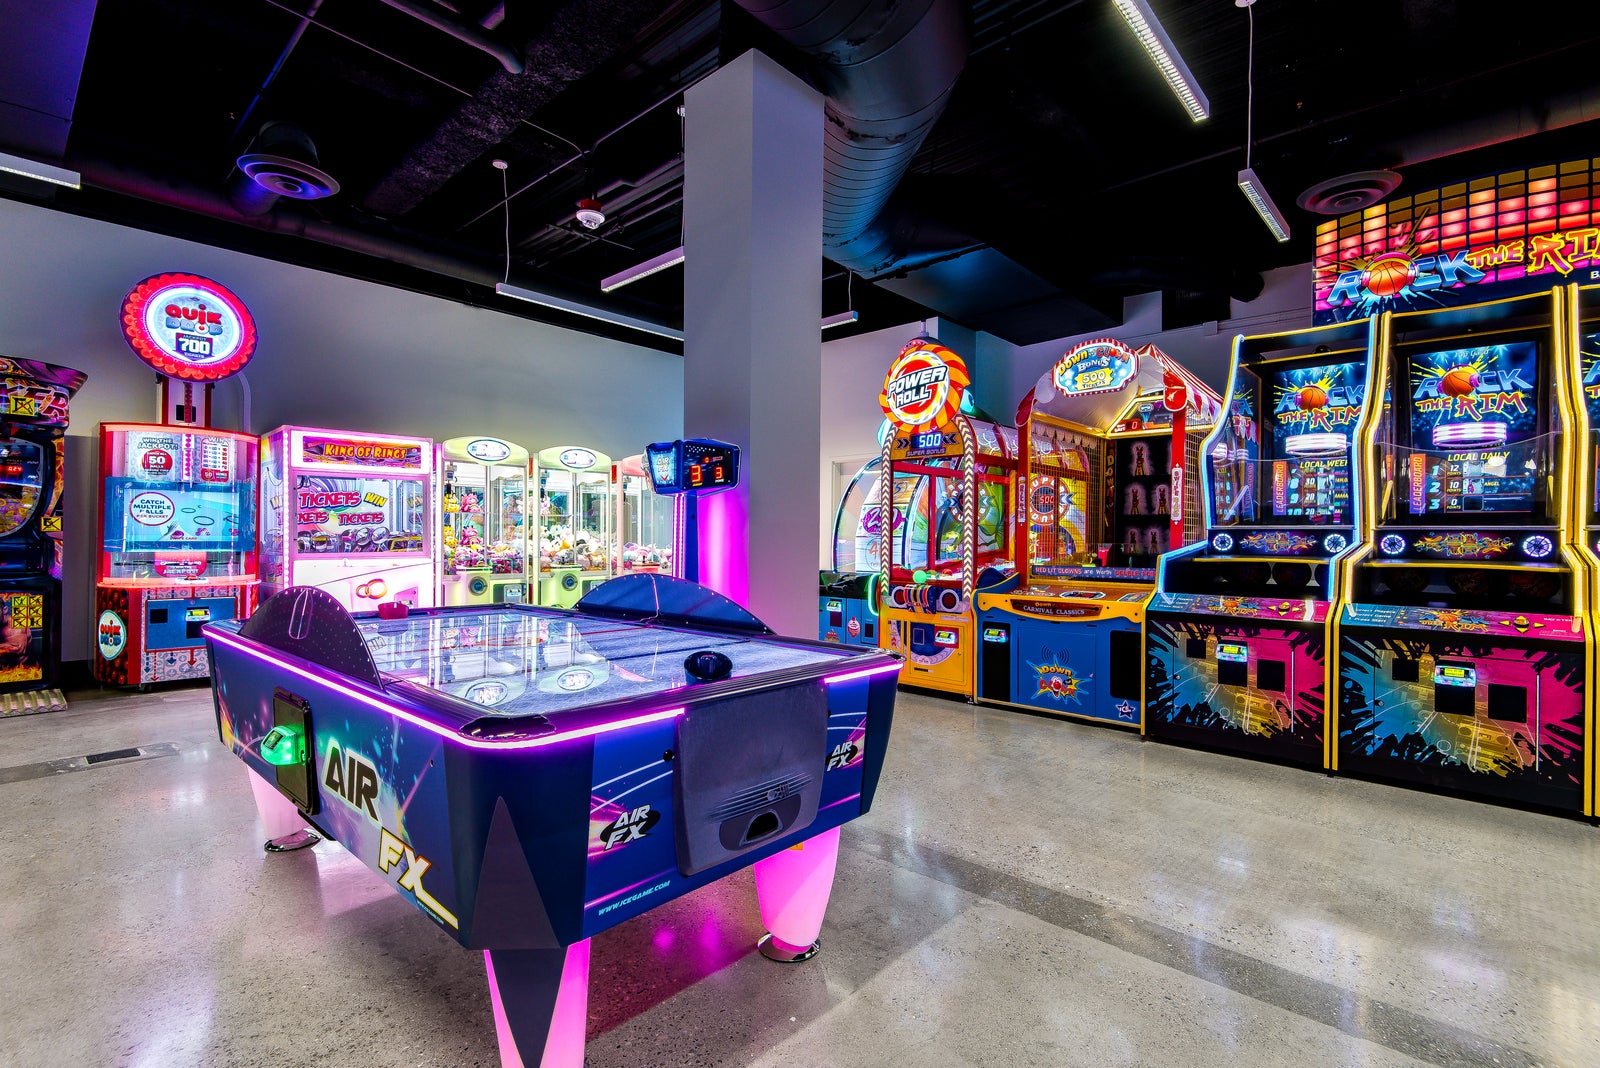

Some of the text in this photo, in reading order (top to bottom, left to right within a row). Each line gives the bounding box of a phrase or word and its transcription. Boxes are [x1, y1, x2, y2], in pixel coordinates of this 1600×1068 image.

[1466, 240, 1525, 269] THE
[1526, 228, 1600, 277] RI
[178, 338, 210, 354] 700
[887, 366, 948, 400] POWER
[1082, 371, 1106, 383] 500
[896, 387, 932, 408] ROLL
[1415, 391, 1528, 422] THE RIM
[1277, 409, 1308, 424] THE
[919, 433, 941, 447] 500
[357, 445, 371, 457] OF
[906, 447, 946, 457] SUPER BONUS
[1447, 453, 1478, 462] LOCAL
[149, 456, 166, 464] 50
[1300, 460, 1324, 469] LOCAL
[691, 465, 723, 483] 3 3
[1413, 456, 1423, 512] LEADERBOARD
[1430, 482, 1440, 493] 2
[1450, 481, 1459, 489] 10
[299, 491, 362, 509] TICKETS
[363, 492, 388, 507] WIN
[1429, 499, 1440, 510] 3
[338, 512, 384, 526] TICKETS
[1023, 605, 1053, 614] CARNIVAL
[831, 741, 853, 757] AIR
[826, 753, 849, 772] FX
[323, 742, 382, 824] AIR
[614, 804, 651, 828] AIR
[604, 821, 648, 851] FX
[378, 826, 459, 930] FX
[598, 880, 671, 916] WWW.ICEGAME.COM
